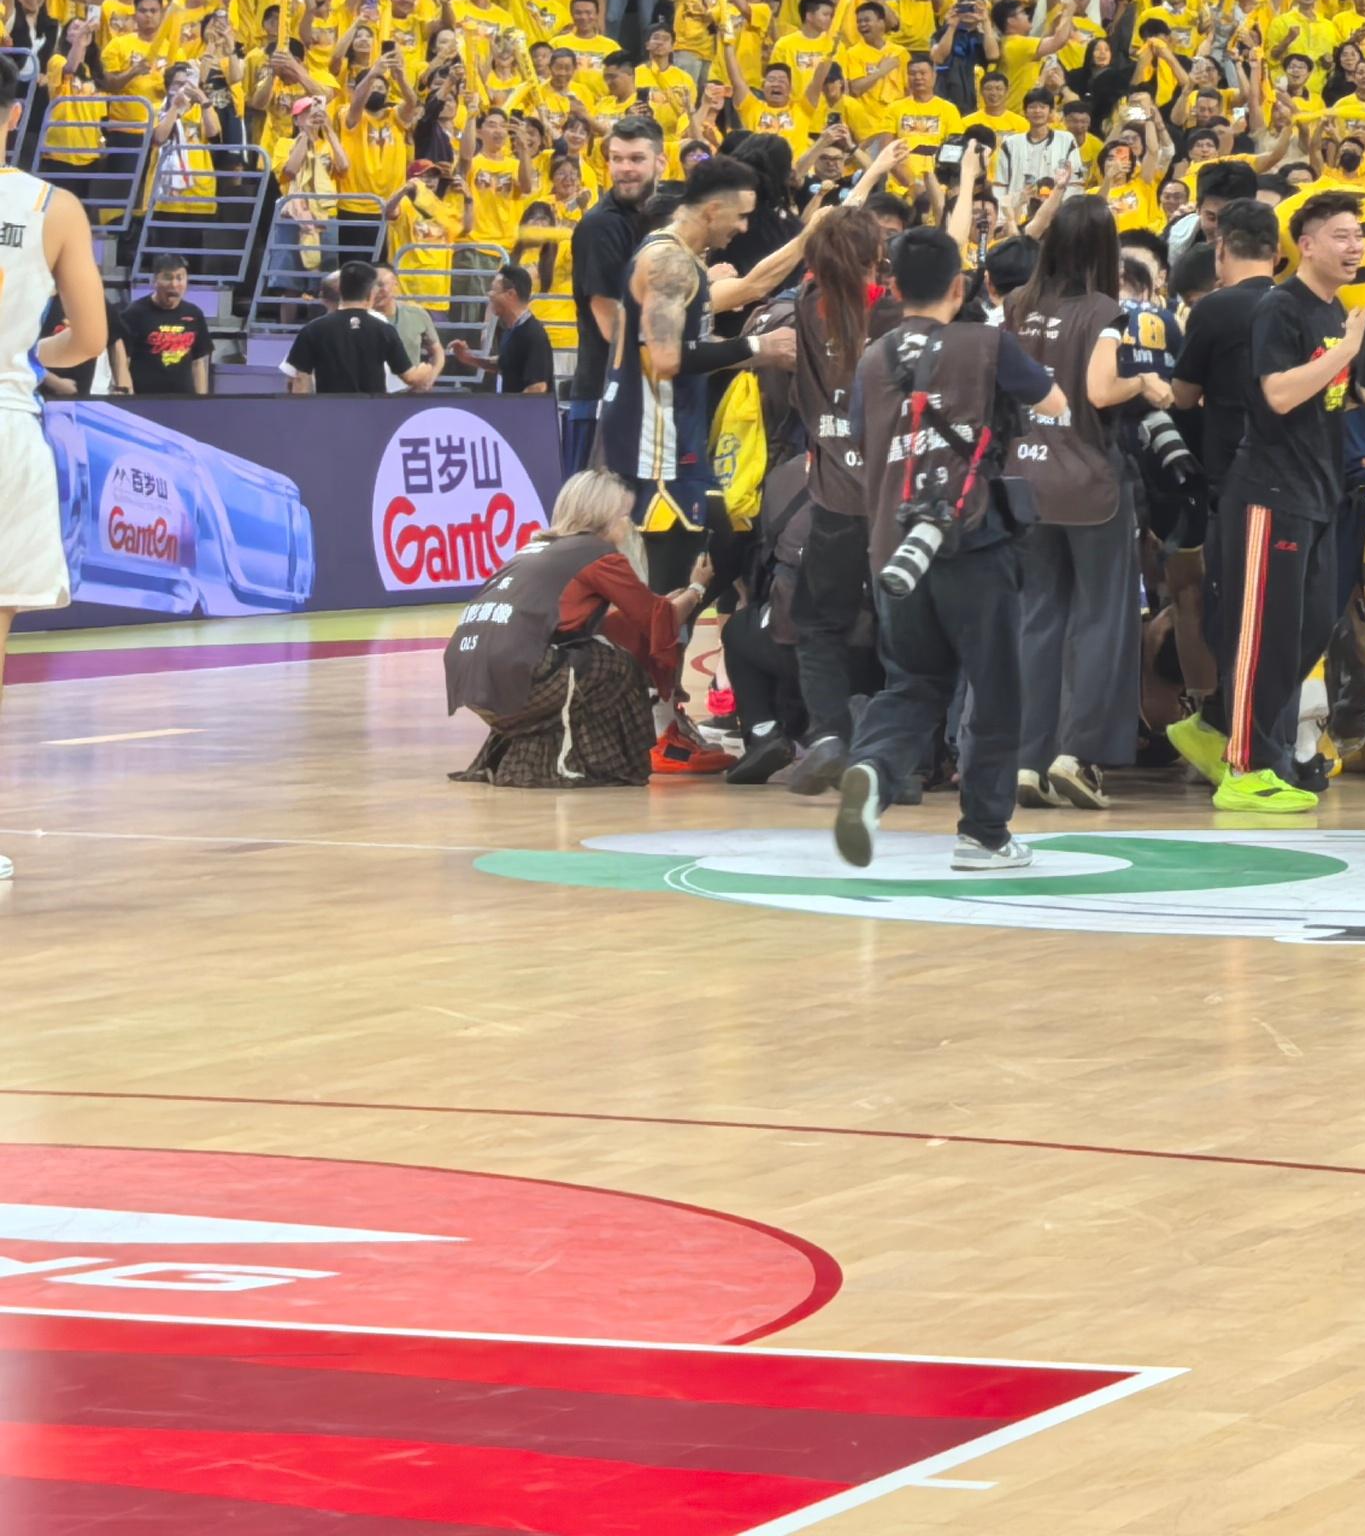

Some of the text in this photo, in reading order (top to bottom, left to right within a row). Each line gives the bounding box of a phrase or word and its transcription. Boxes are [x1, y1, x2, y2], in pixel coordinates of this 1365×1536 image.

[399, 435, 500, 494] 百岁山
[1017, 443, 1048, 461] 042
[131, 467, 168, 500] 百岁山
[108, 505, 178, 563] Ganten
